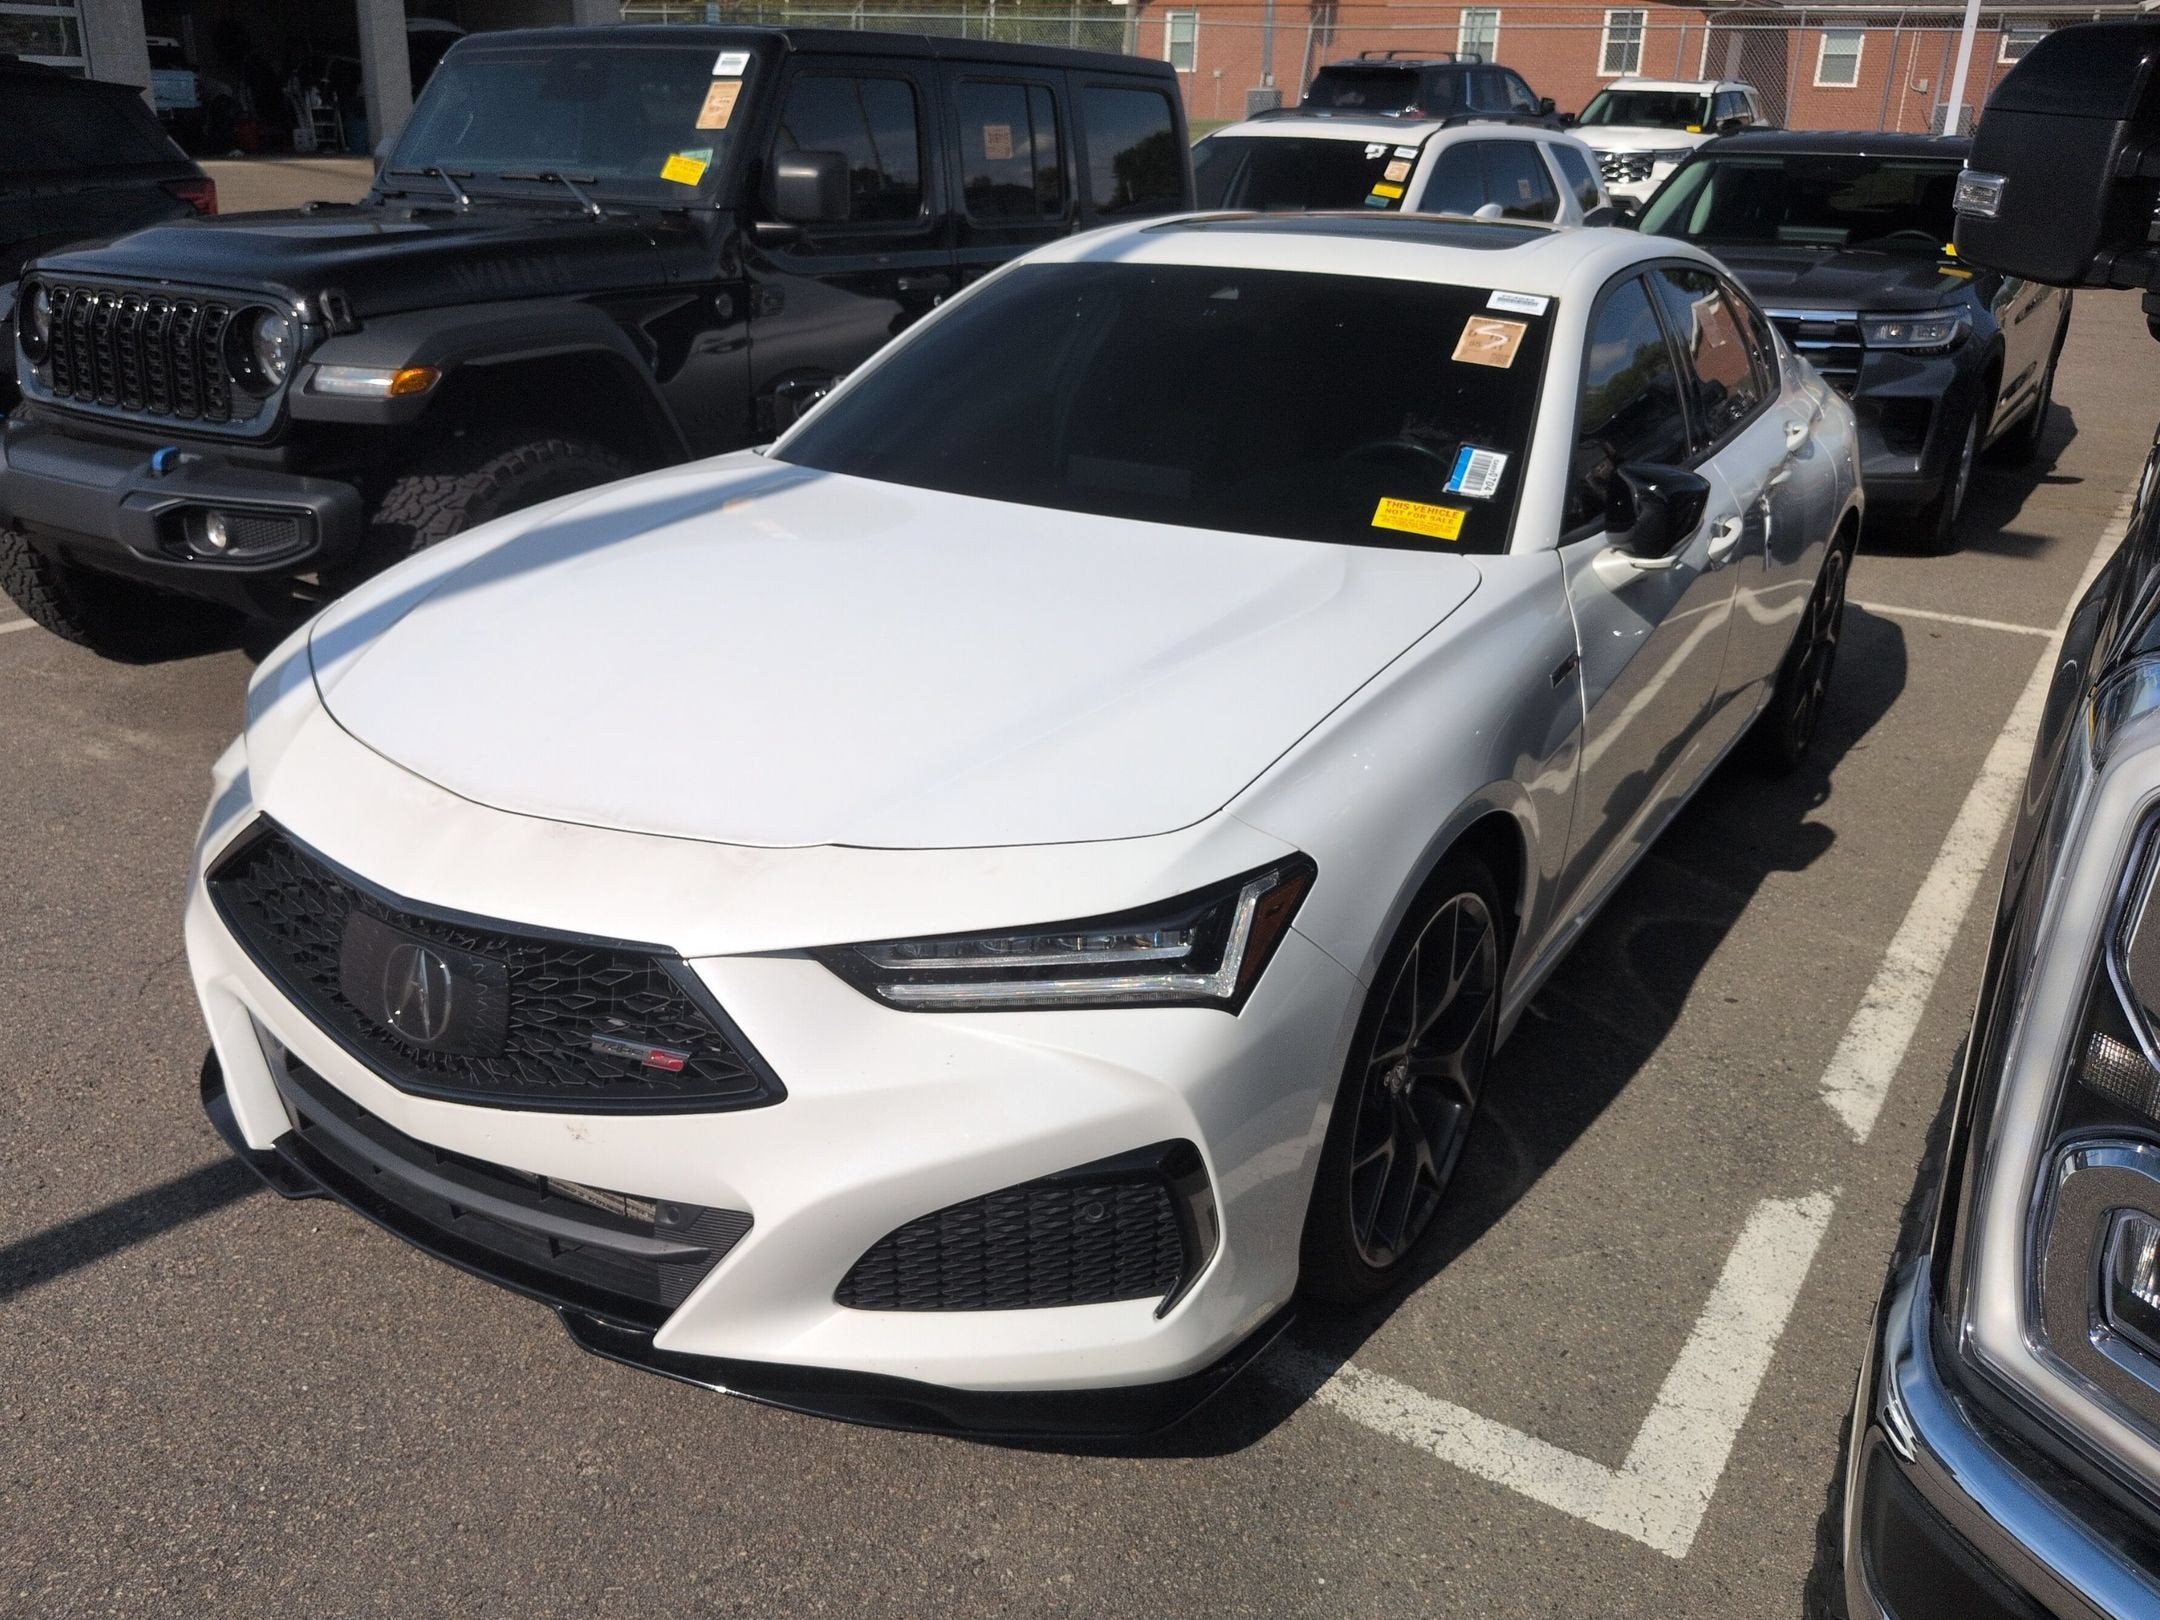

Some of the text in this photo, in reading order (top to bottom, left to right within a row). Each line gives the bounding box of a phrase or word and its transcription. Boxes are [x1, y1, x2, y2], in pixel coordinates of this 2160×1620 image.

[1385, 500, 1459, 519] THIS VEHICLE
[1407, 511, 1426, 519] FOR
[1430, 515, 1454, 524] SALE
